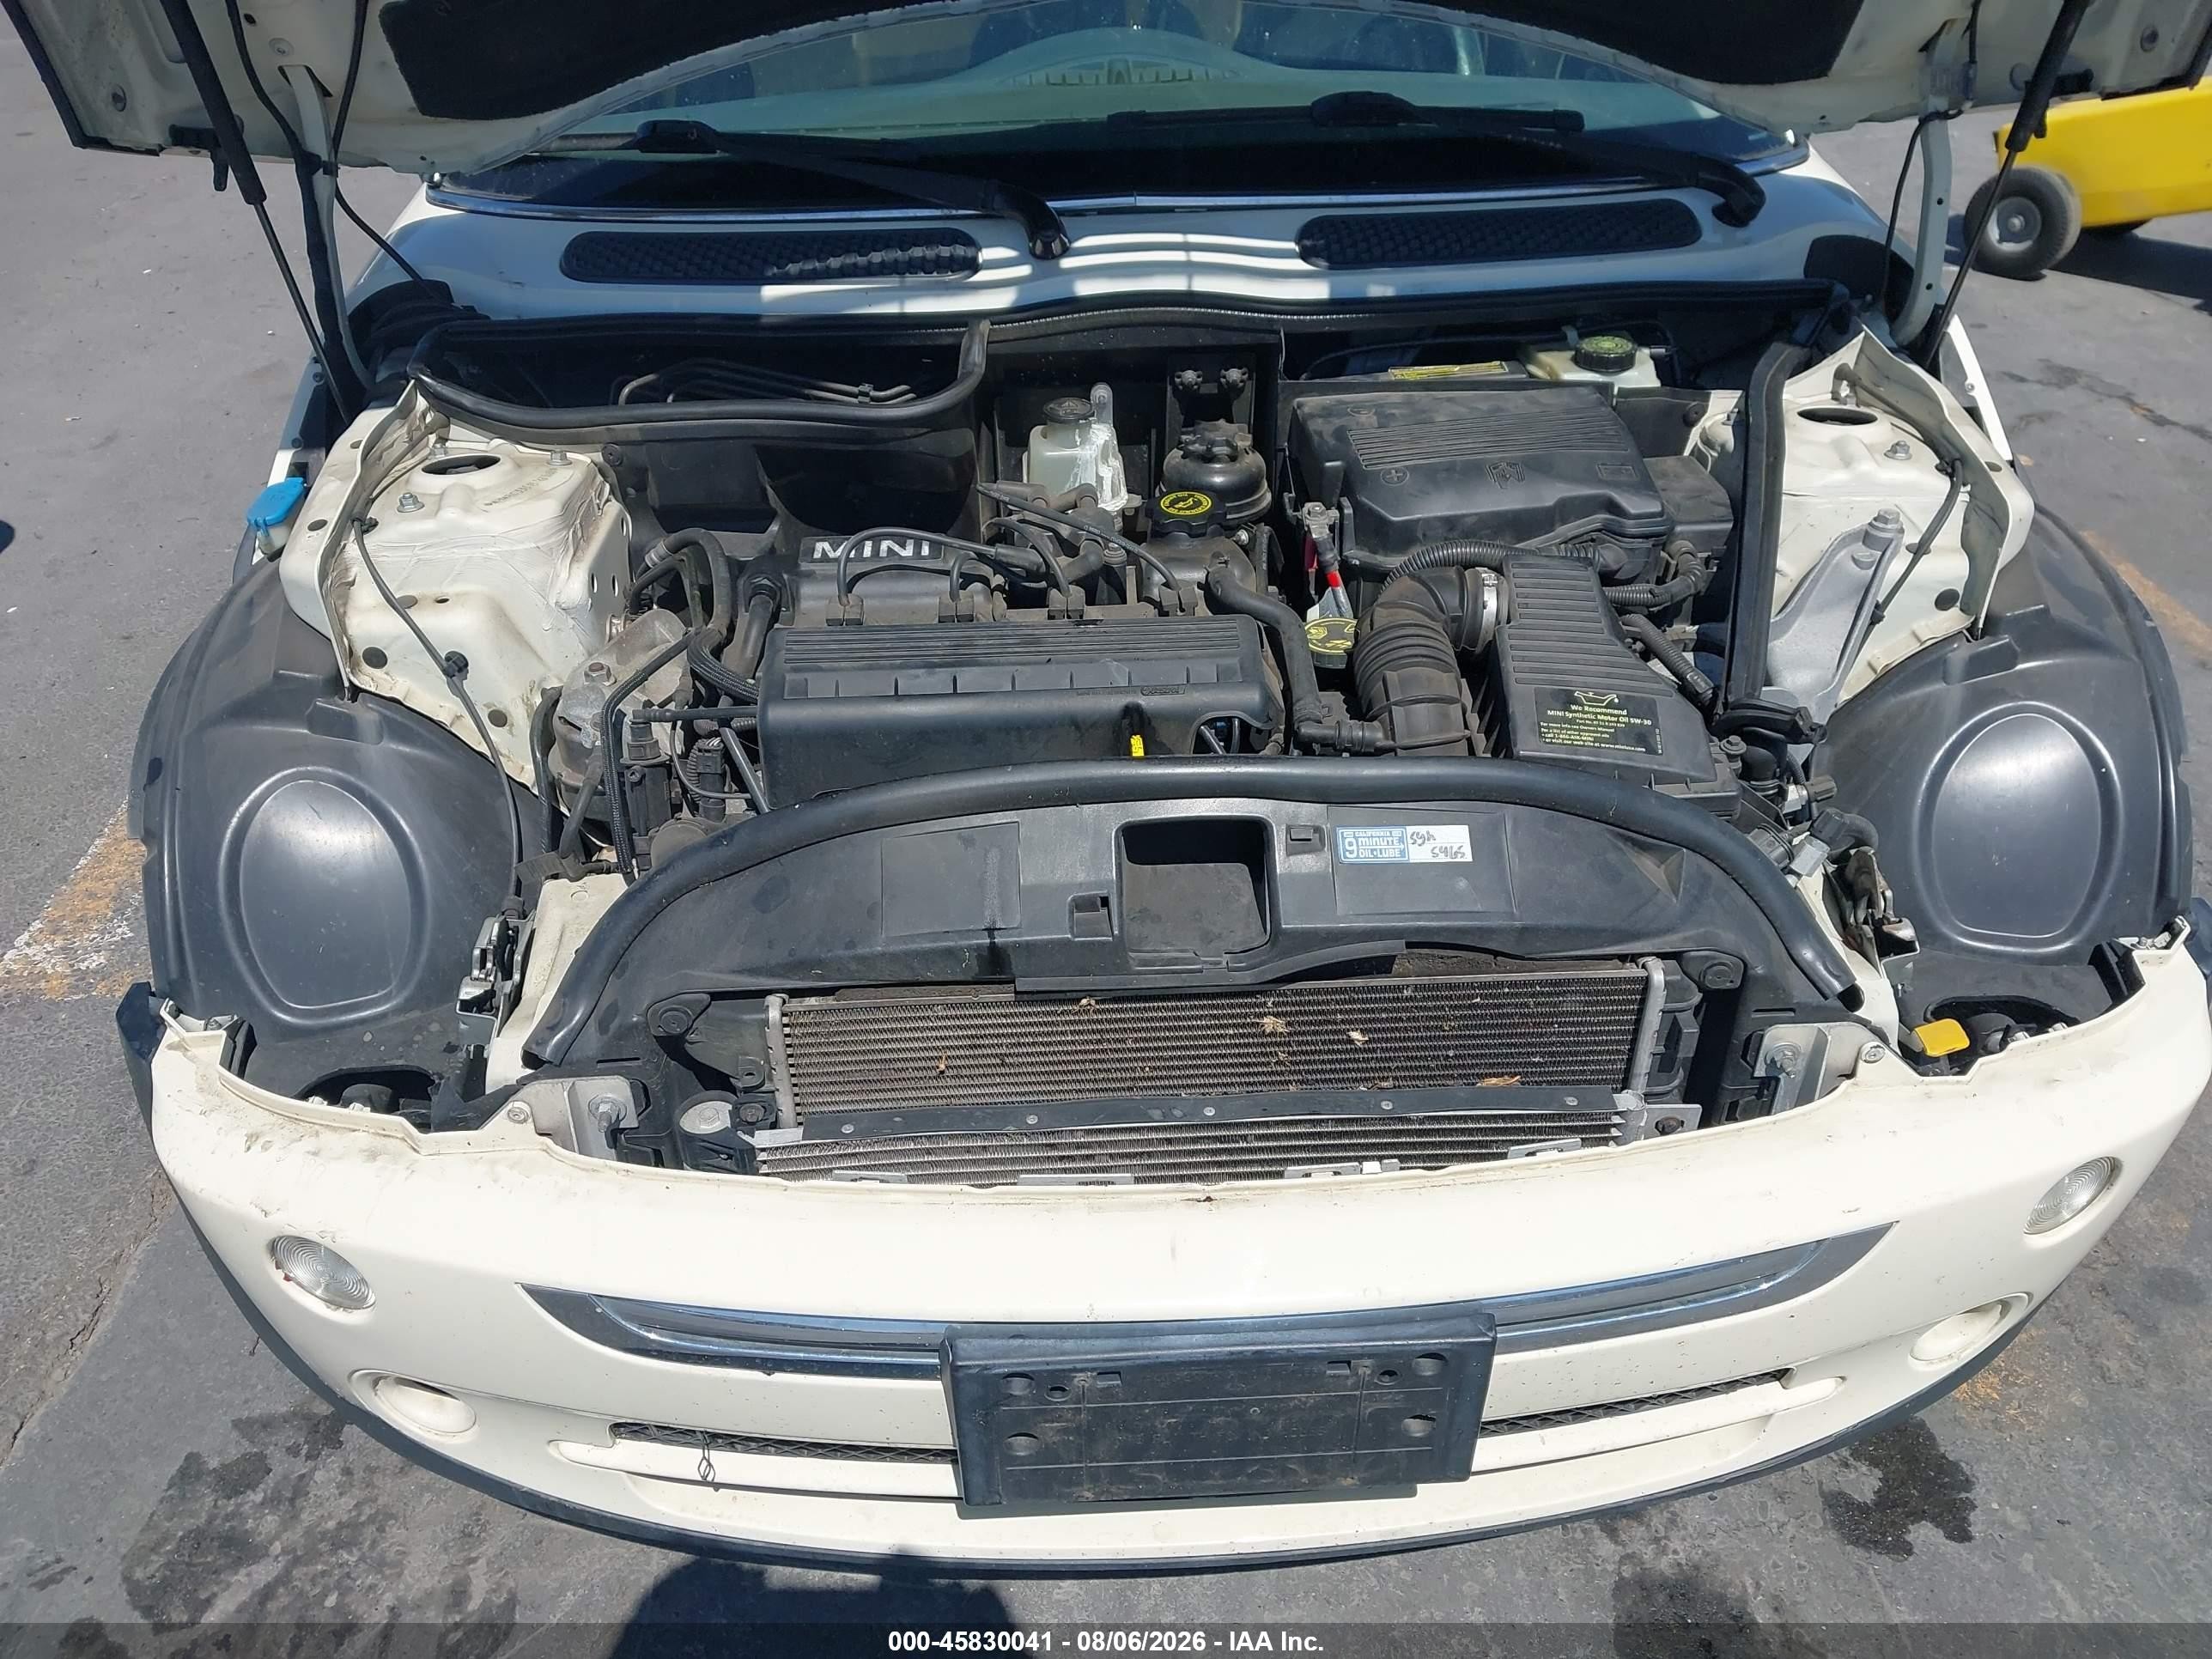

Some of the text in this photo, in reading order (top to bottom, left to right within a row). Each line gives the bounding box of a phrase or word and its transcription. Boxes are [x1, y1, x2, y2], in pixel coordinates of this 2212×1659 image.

[813, 539, 930, 559] MINI
[1565, 711, 1595, 720] Synthetic
[1584, 706, 1626, 715] Recommend
[1345, 837, 1357, 858] 9
